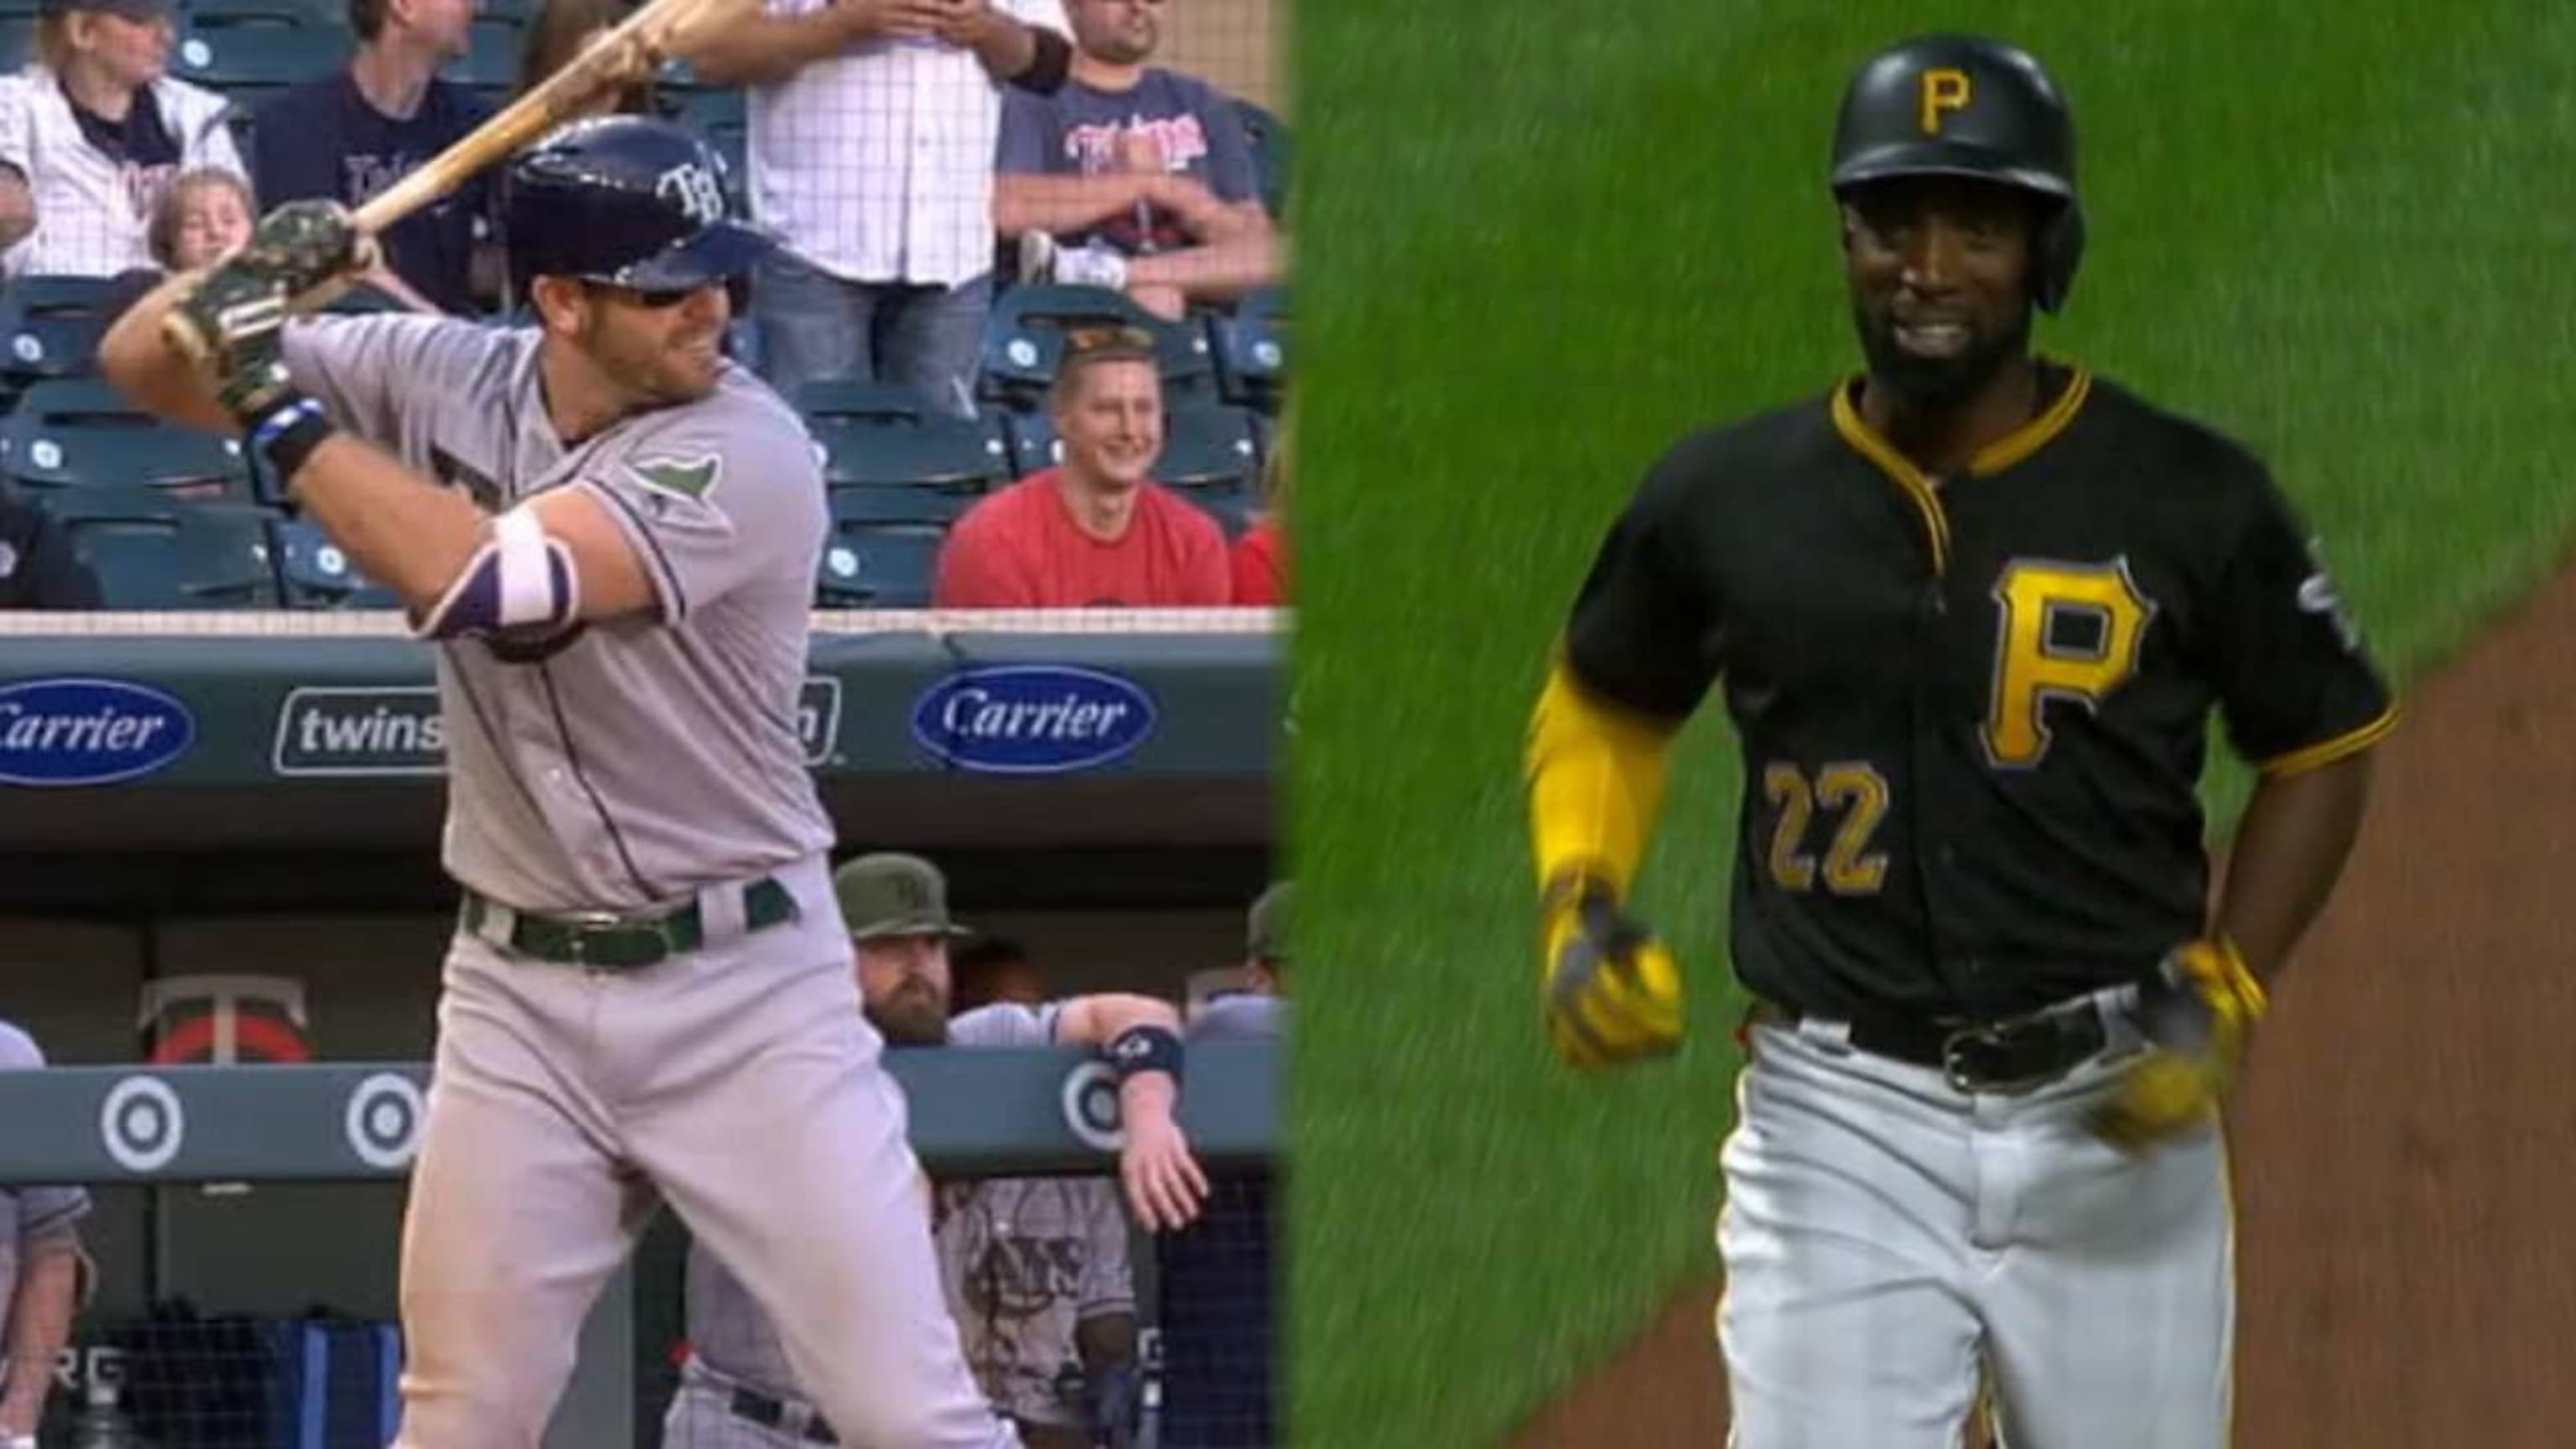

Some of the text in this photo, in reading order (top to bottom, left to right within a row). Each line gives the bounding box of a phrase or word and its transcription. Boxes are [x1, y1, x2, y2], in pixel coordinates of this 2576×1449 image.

[1920, 66, 1972, 134] P
[656, 162, 724, 227] TB
[1980, 553, 2158, 769] P
[299, 705, 444, 750] twins
[942, 688, 1127, 739] Carrier
[1764, 761, 1889, 896] 22
